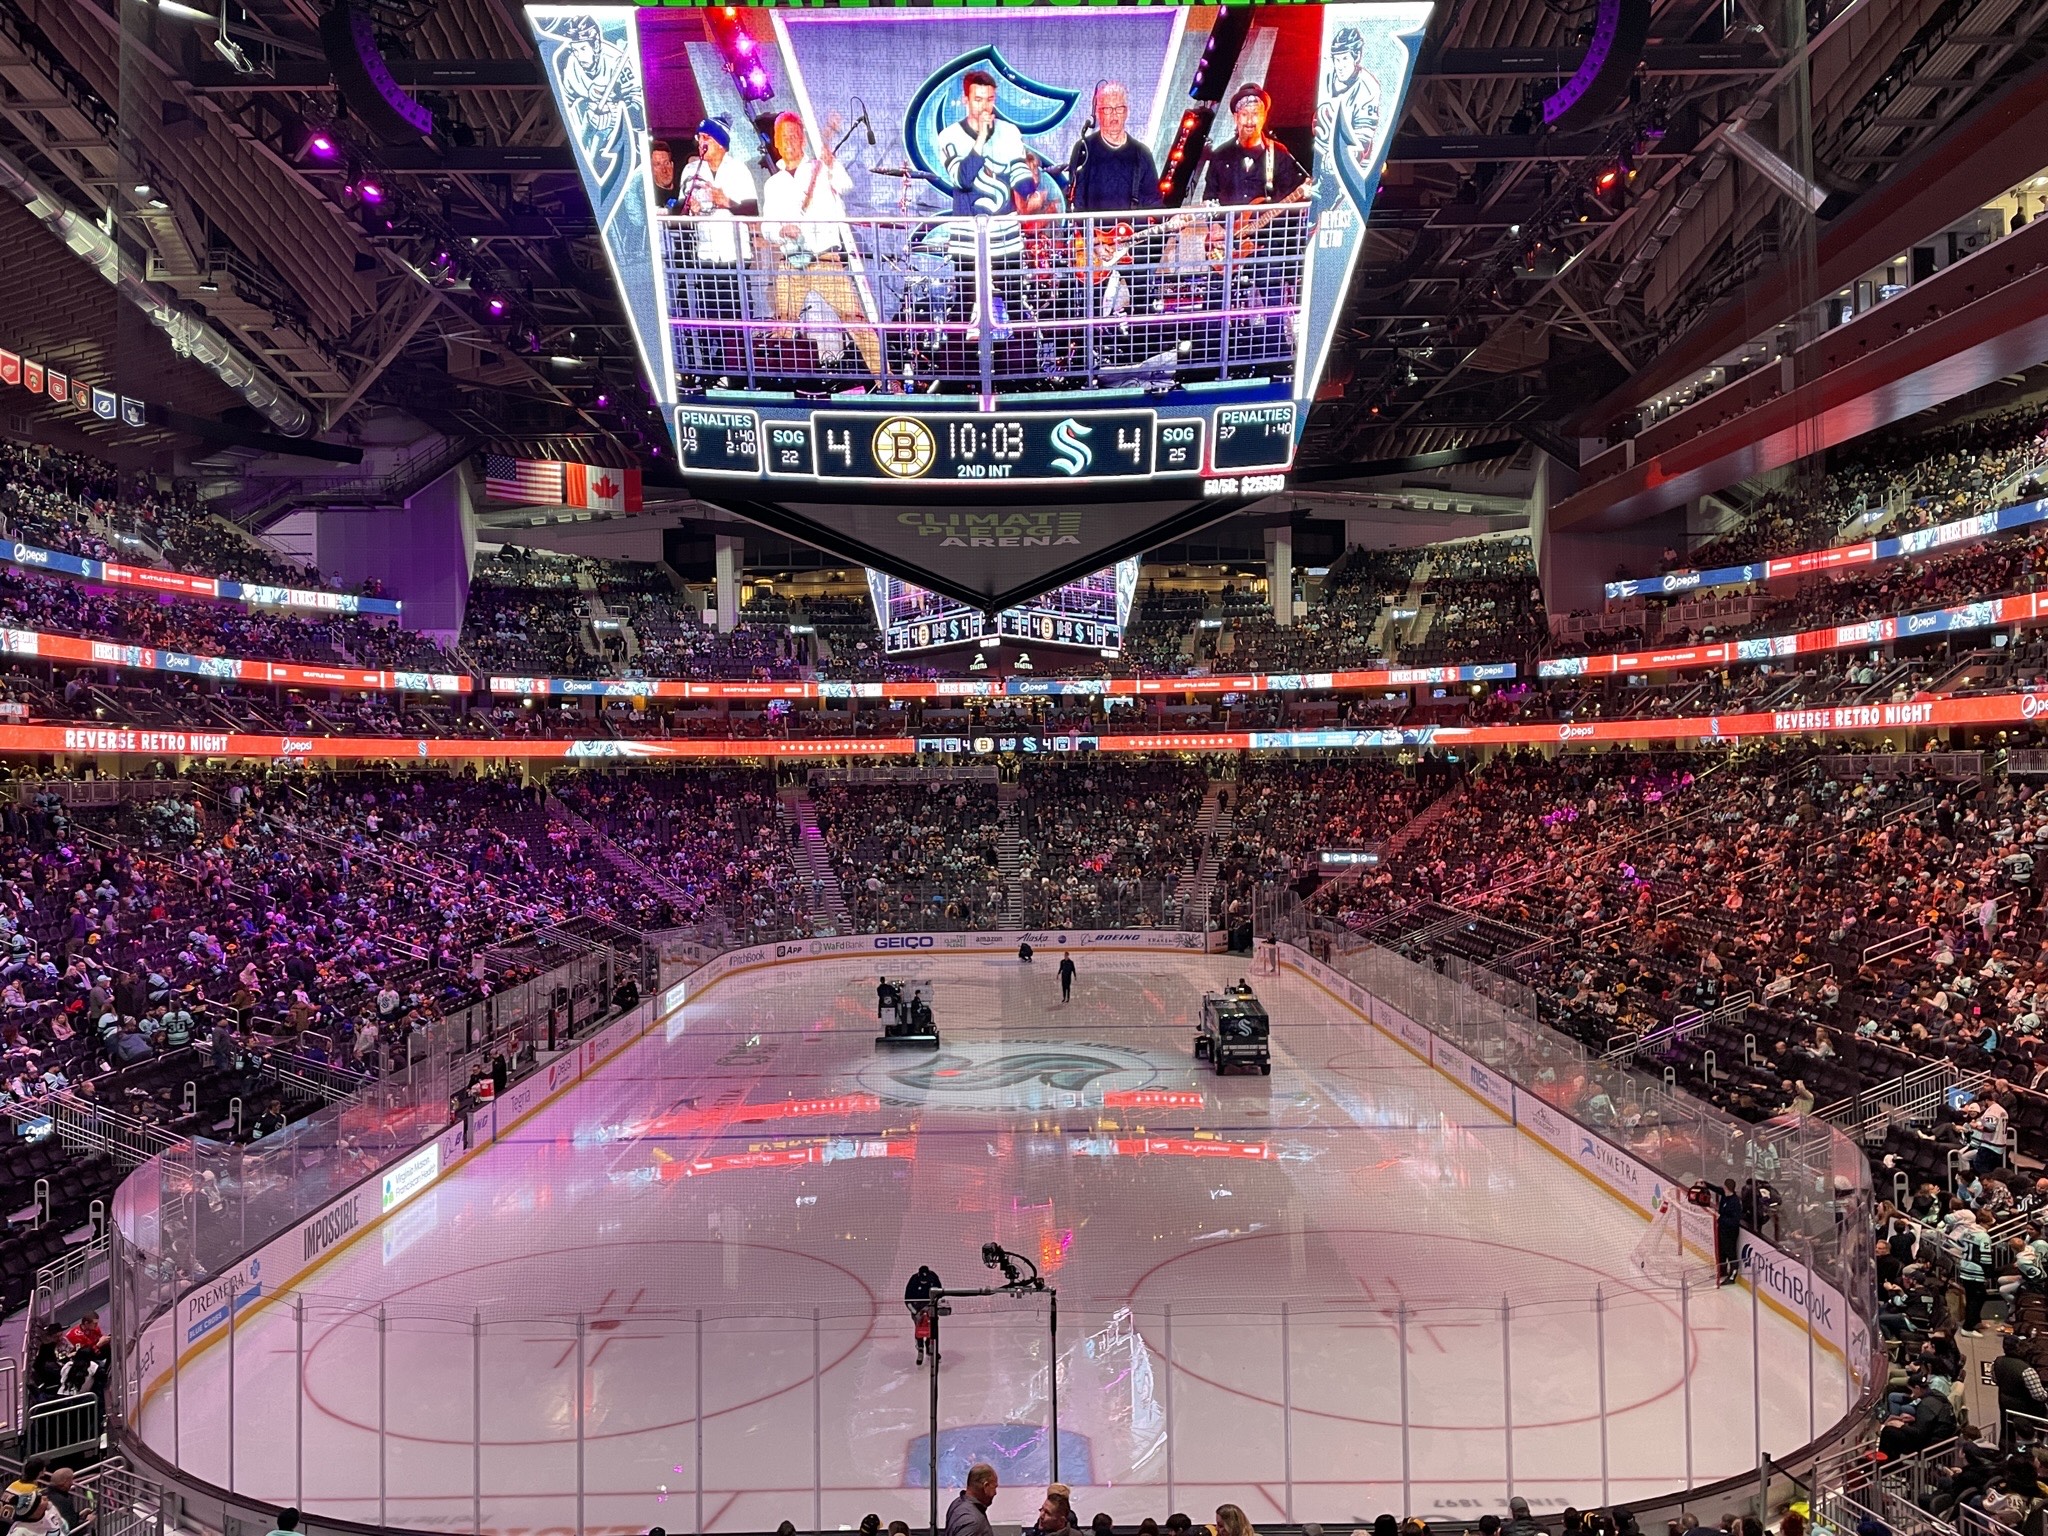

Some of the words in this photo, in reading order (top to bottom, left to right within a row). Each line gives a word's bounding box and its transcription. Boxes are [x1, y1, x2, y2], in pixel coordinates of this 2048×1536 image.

[682, 413, 752, 427] PENALTIES
[1222, 409, 1291, 425] PENALTIES
[682, 427, 696, 439] 10
[727, 429, 755, 442] 1:40
[773, 430, 805, 443] SOG
[1163, 428, 1195, 441] SOG
[1220, 426, 1236, 439] 37
[1265, 423, 1292, 436] 1:40
[682, 439, 697, 451] 73
[726, 441, 756, 454] 2:00
[828, 429, 850, 466] 4
[950, 422, 1024, 459] 10:03
[1118, 428, 1140, 464] 4
[781, 450, 799, 463] 22
[1169, 448, 1187, 461] 25
[957, 464, 986, 477] 2ND
[988, 464, 1013, 477] INT
[897, 512, 1082, 526] CLIMATE
[918, 525, 1081, 536] PLEDGE
[939, 535, 1081, 547] ARENA
[1676, 574, 1700, 588] pepsi
[1775, 711, 1830, 729] REVERSE
[1835, 708, 1880, 728] RETRO
[1885, 703, 1933, 725] NIGHT
[1571, 725, 1594, 738] pepsi
[65, 730, 136, 751] REVERSE
[141, 732, 185, 751] RETRO
[190, 734, 228, 752] NIGHT
[289, 739, 312, 753] pepsi
[874, 936, 934, 949] GEICO
[1016, 932, 1049, 942] Alaska
[168, 1021, 186, 1034] 30
[1596, 1145, 1638, 1185] SYMETRA
[303, 1194, 360, 1262] IMPOSSIBLE
[189, 1270, 246, 1322] PREMERA
[1754, 1251, 1833, 1331] PitchBook
[189, 1323, 203, 1339] BLUE
[203, 1311, 222, 1329] CROSS
[1433, 1498, 1481, 1509] 1897
